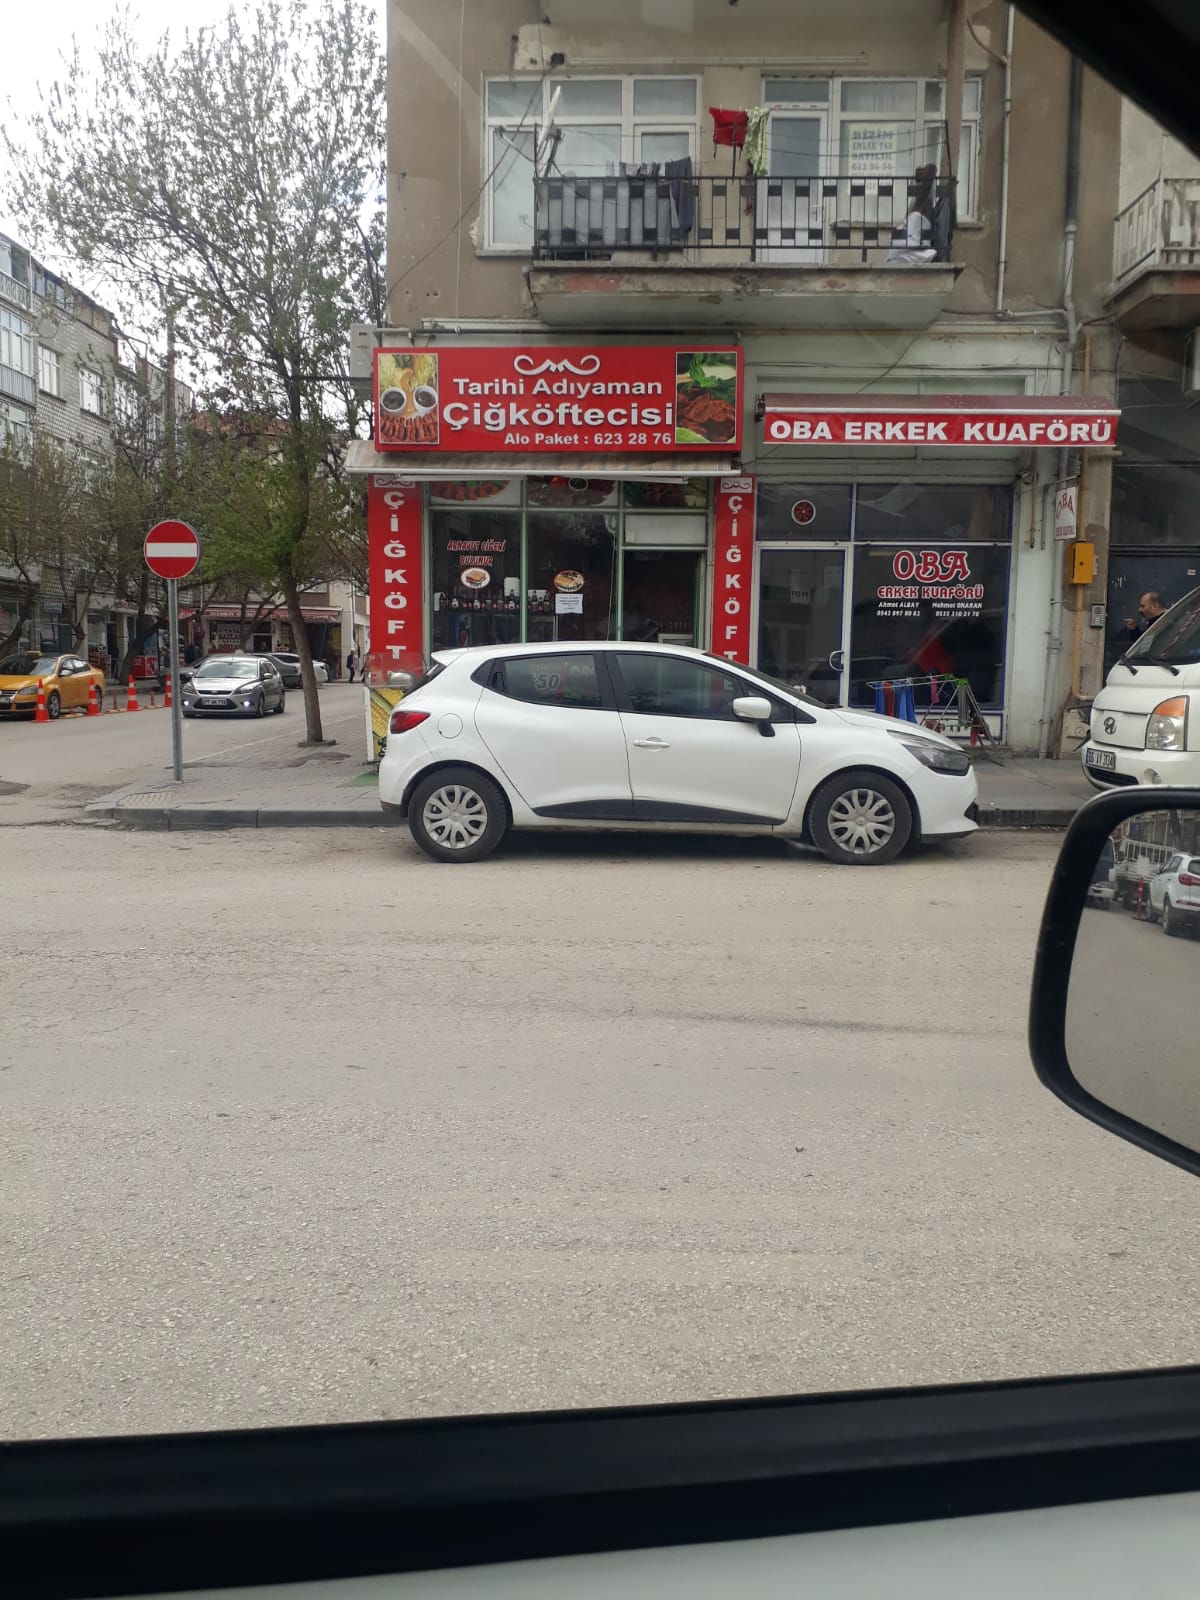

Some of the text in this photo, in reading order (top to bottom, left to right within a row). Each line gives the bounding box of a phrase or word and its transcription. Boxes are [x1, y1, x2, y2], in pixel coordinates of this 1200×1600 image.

[453, 378, 662, 399] Tarihi Adıyaman
[442, 402, 673, 432] Çiğköftecisi
[504, 433, 530, 445] Alo
[535, 433, 579, 445] Paket
[594, 432, 623, 445] 623
[628, 432, 647, 445] 28
[653, 432, 672, 445] 76
[770, 418, 1112, 442] OBA ERKEK KUAFÖRÜ
[383, 491, 408, 660] ÇİĞKÖFT
[893, 550, 971, 583] OBA
[877, 584, 984, 600] ERKEK KUAFÖRÜ
